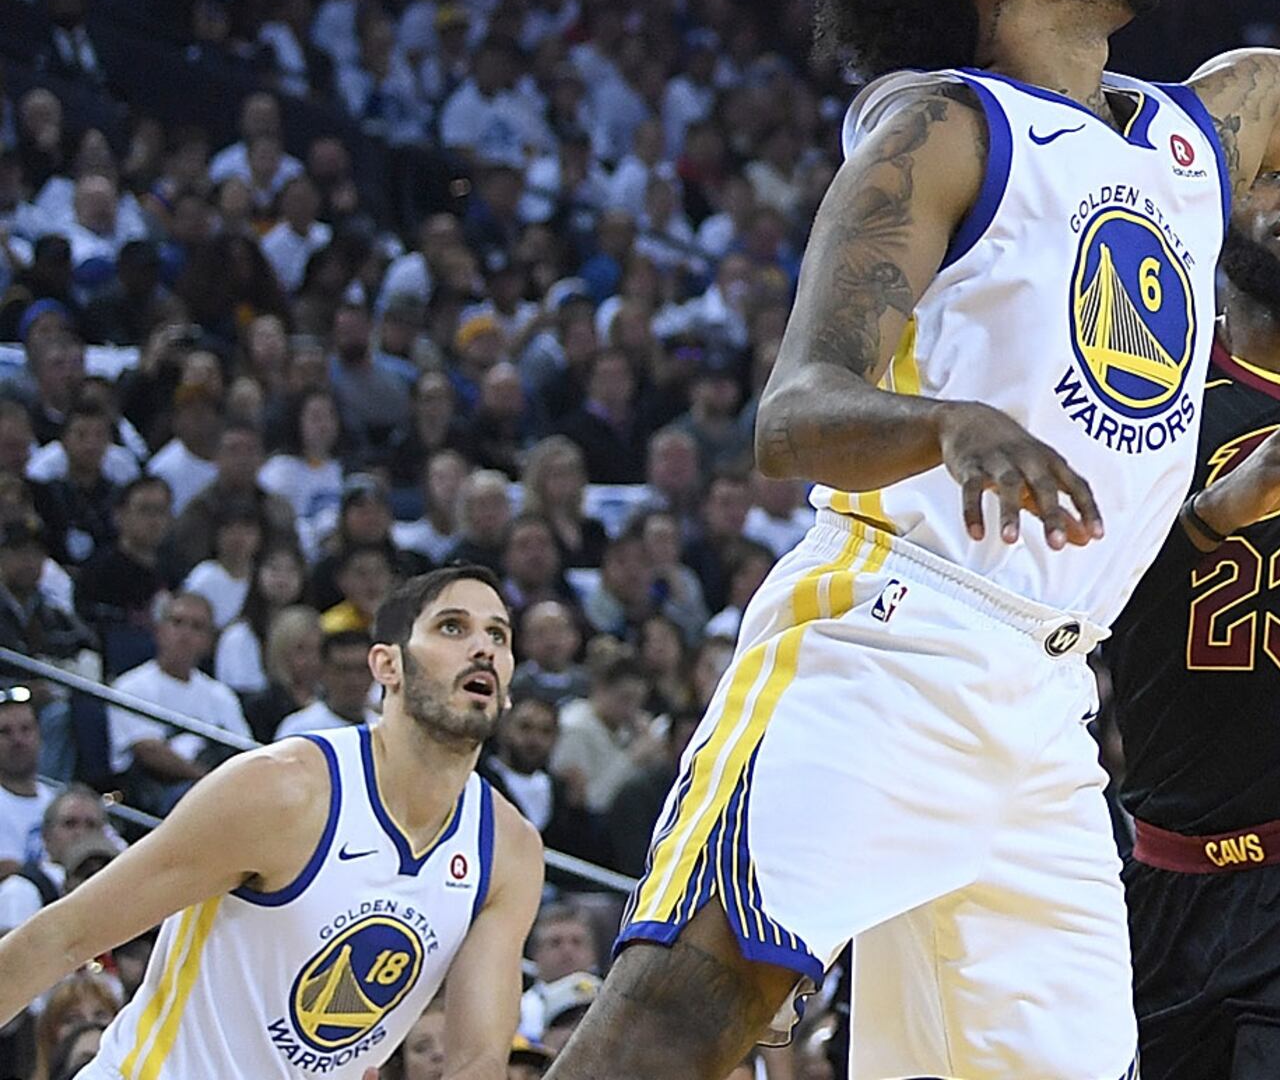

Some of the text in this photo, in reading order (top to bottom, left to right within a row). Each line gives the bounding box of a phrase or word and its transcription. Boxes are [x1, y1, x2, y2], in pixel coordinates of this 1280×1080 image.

[1070, 184, 1195, 270] GOLDEN STATE
[1138, 257, 1163, 312] 6
[1054, 366, 1195, 453] WARRIORS
[1204, 833, 1265, 867] CAVS
[319, 899, 441, 954] GOLDEN STATE
[365, 949, 410, 985] 18
[268, 1017, 387, 1074] WARRIORS
